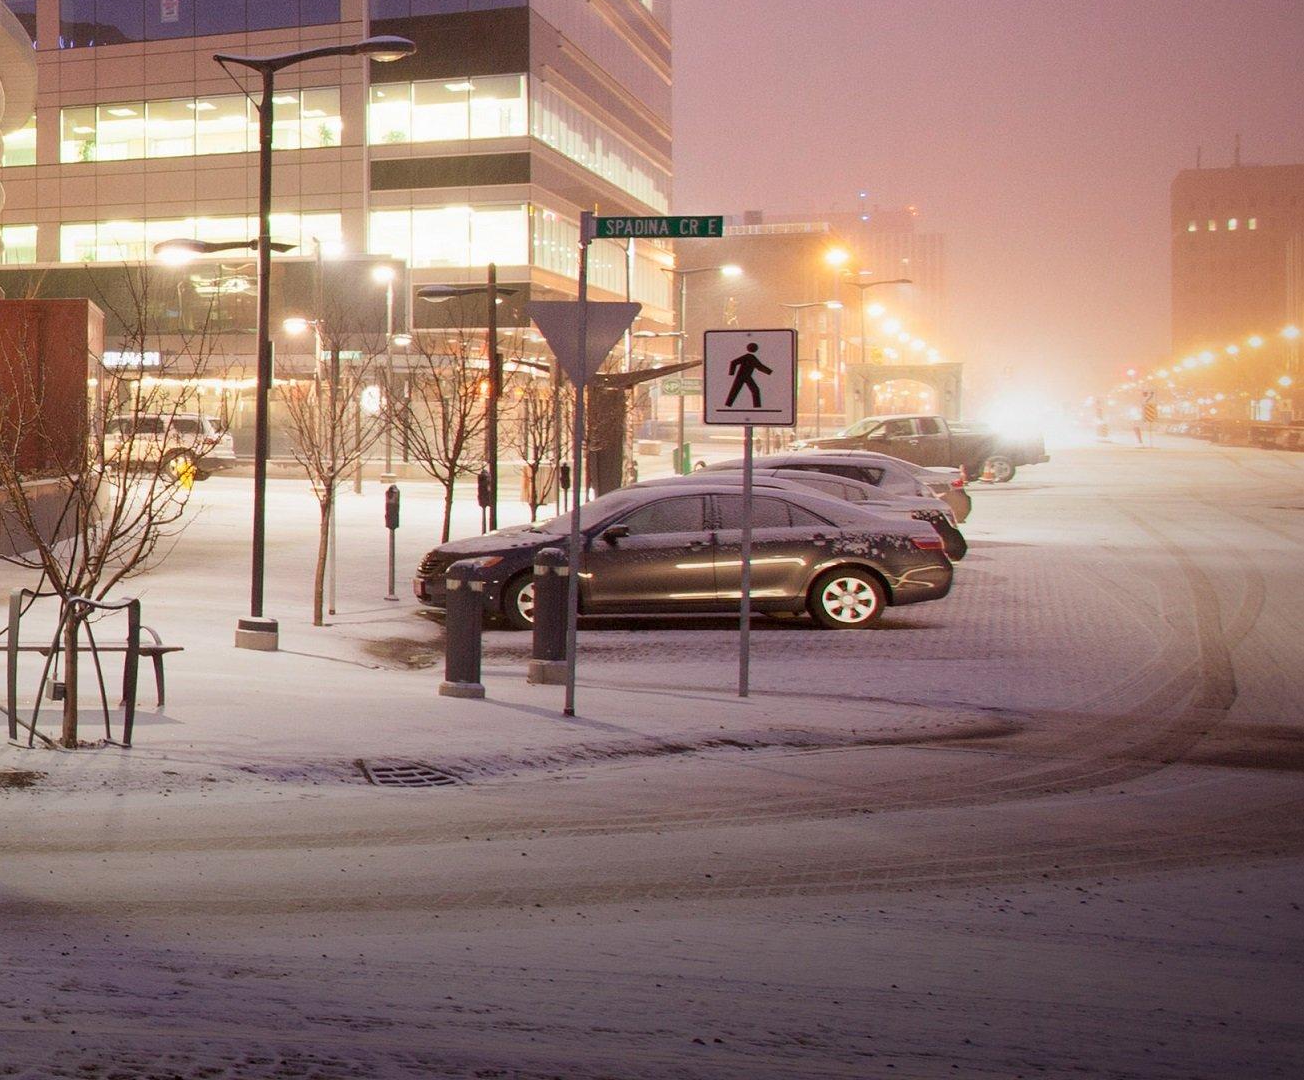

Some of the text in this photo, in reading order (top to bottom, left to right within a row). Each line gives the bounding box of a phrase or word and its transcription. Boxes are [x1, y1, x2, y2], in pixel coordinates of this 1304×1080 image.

[606, 218, 717, 235] SPADINA CR E
